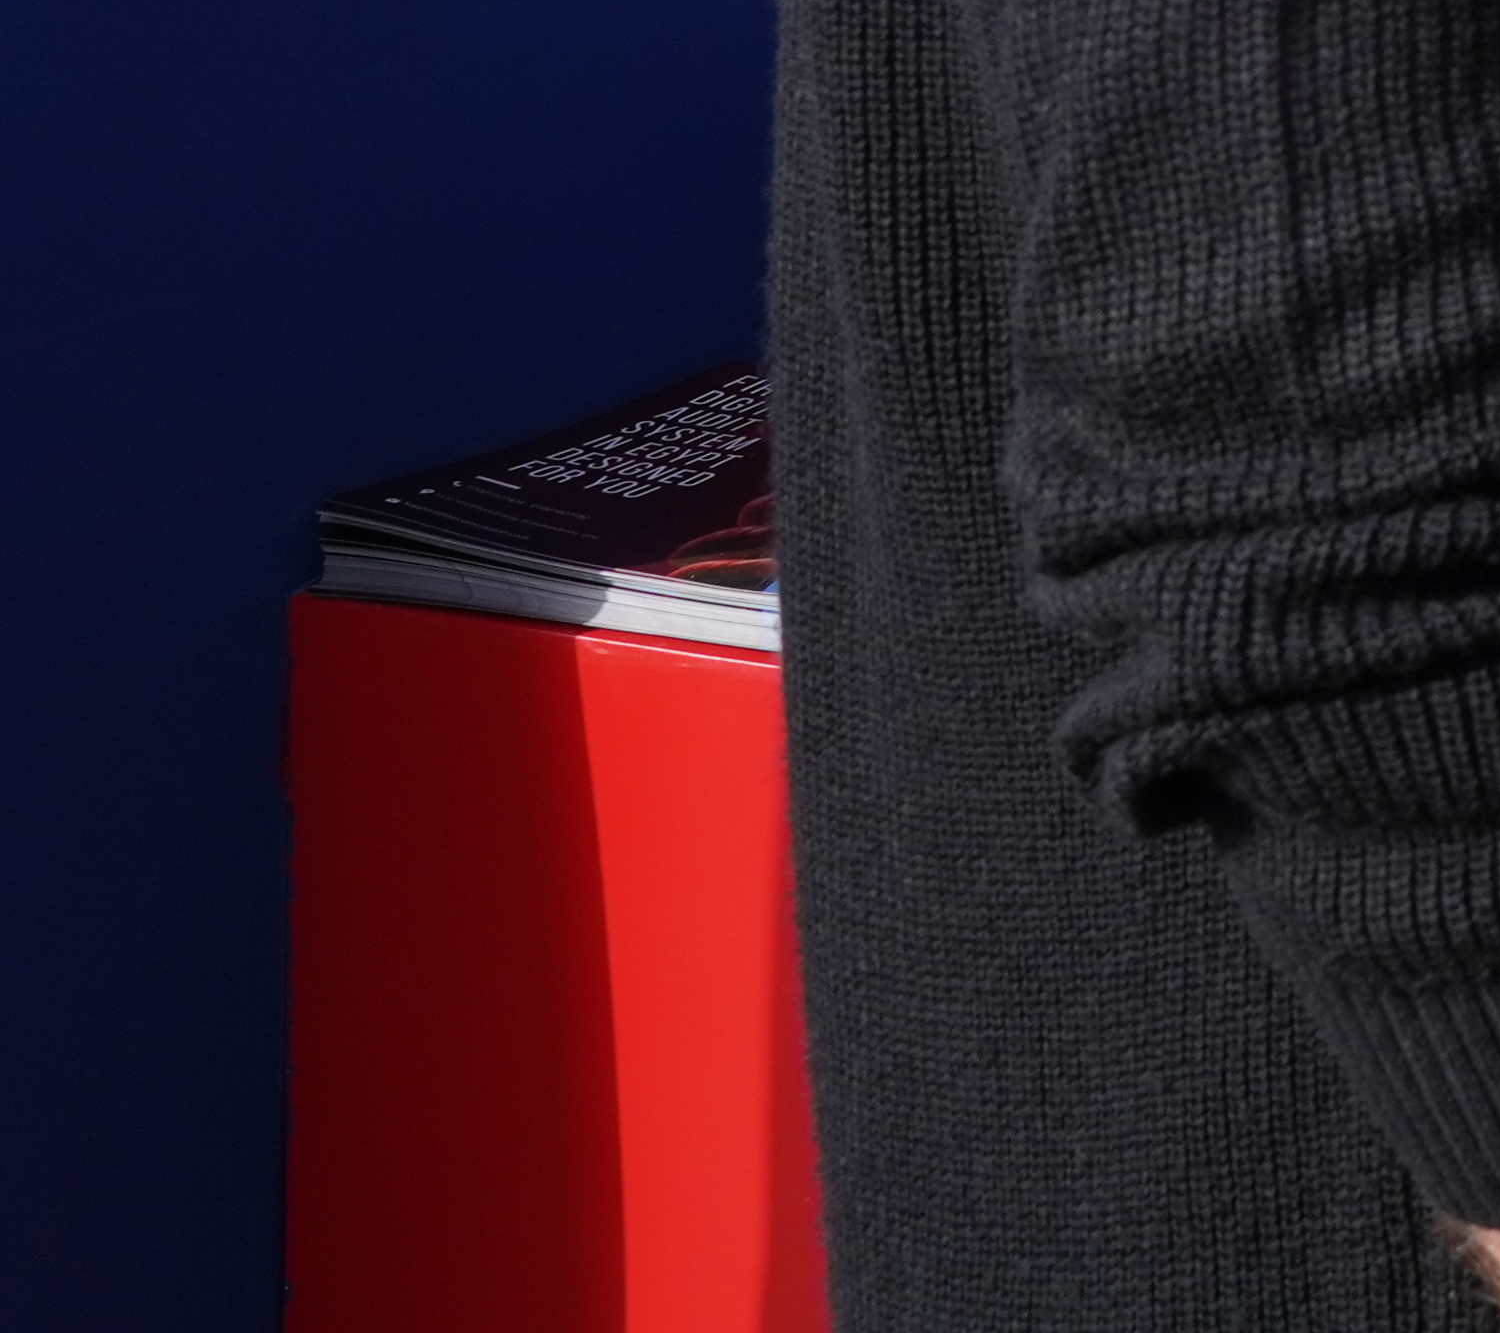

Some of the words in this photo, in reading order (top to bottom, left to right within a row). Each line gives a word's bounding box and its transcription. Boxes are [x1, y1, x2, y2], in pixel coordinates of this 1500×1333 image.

[723, 374, 772, 397] FIR
[654, 406, 765, 432] AUDIT
[689, 389, 770, 417] DIGI
[583, 433, 632, 452] IN
[626, 439, 744, 469] EGYPT
[622, 419, 762, 452] SYSTEM
[508, 460, 587, 484] FOR
[586, 475, 662, 499] YOU
[546, 447, 716, 488] DESIGNED
